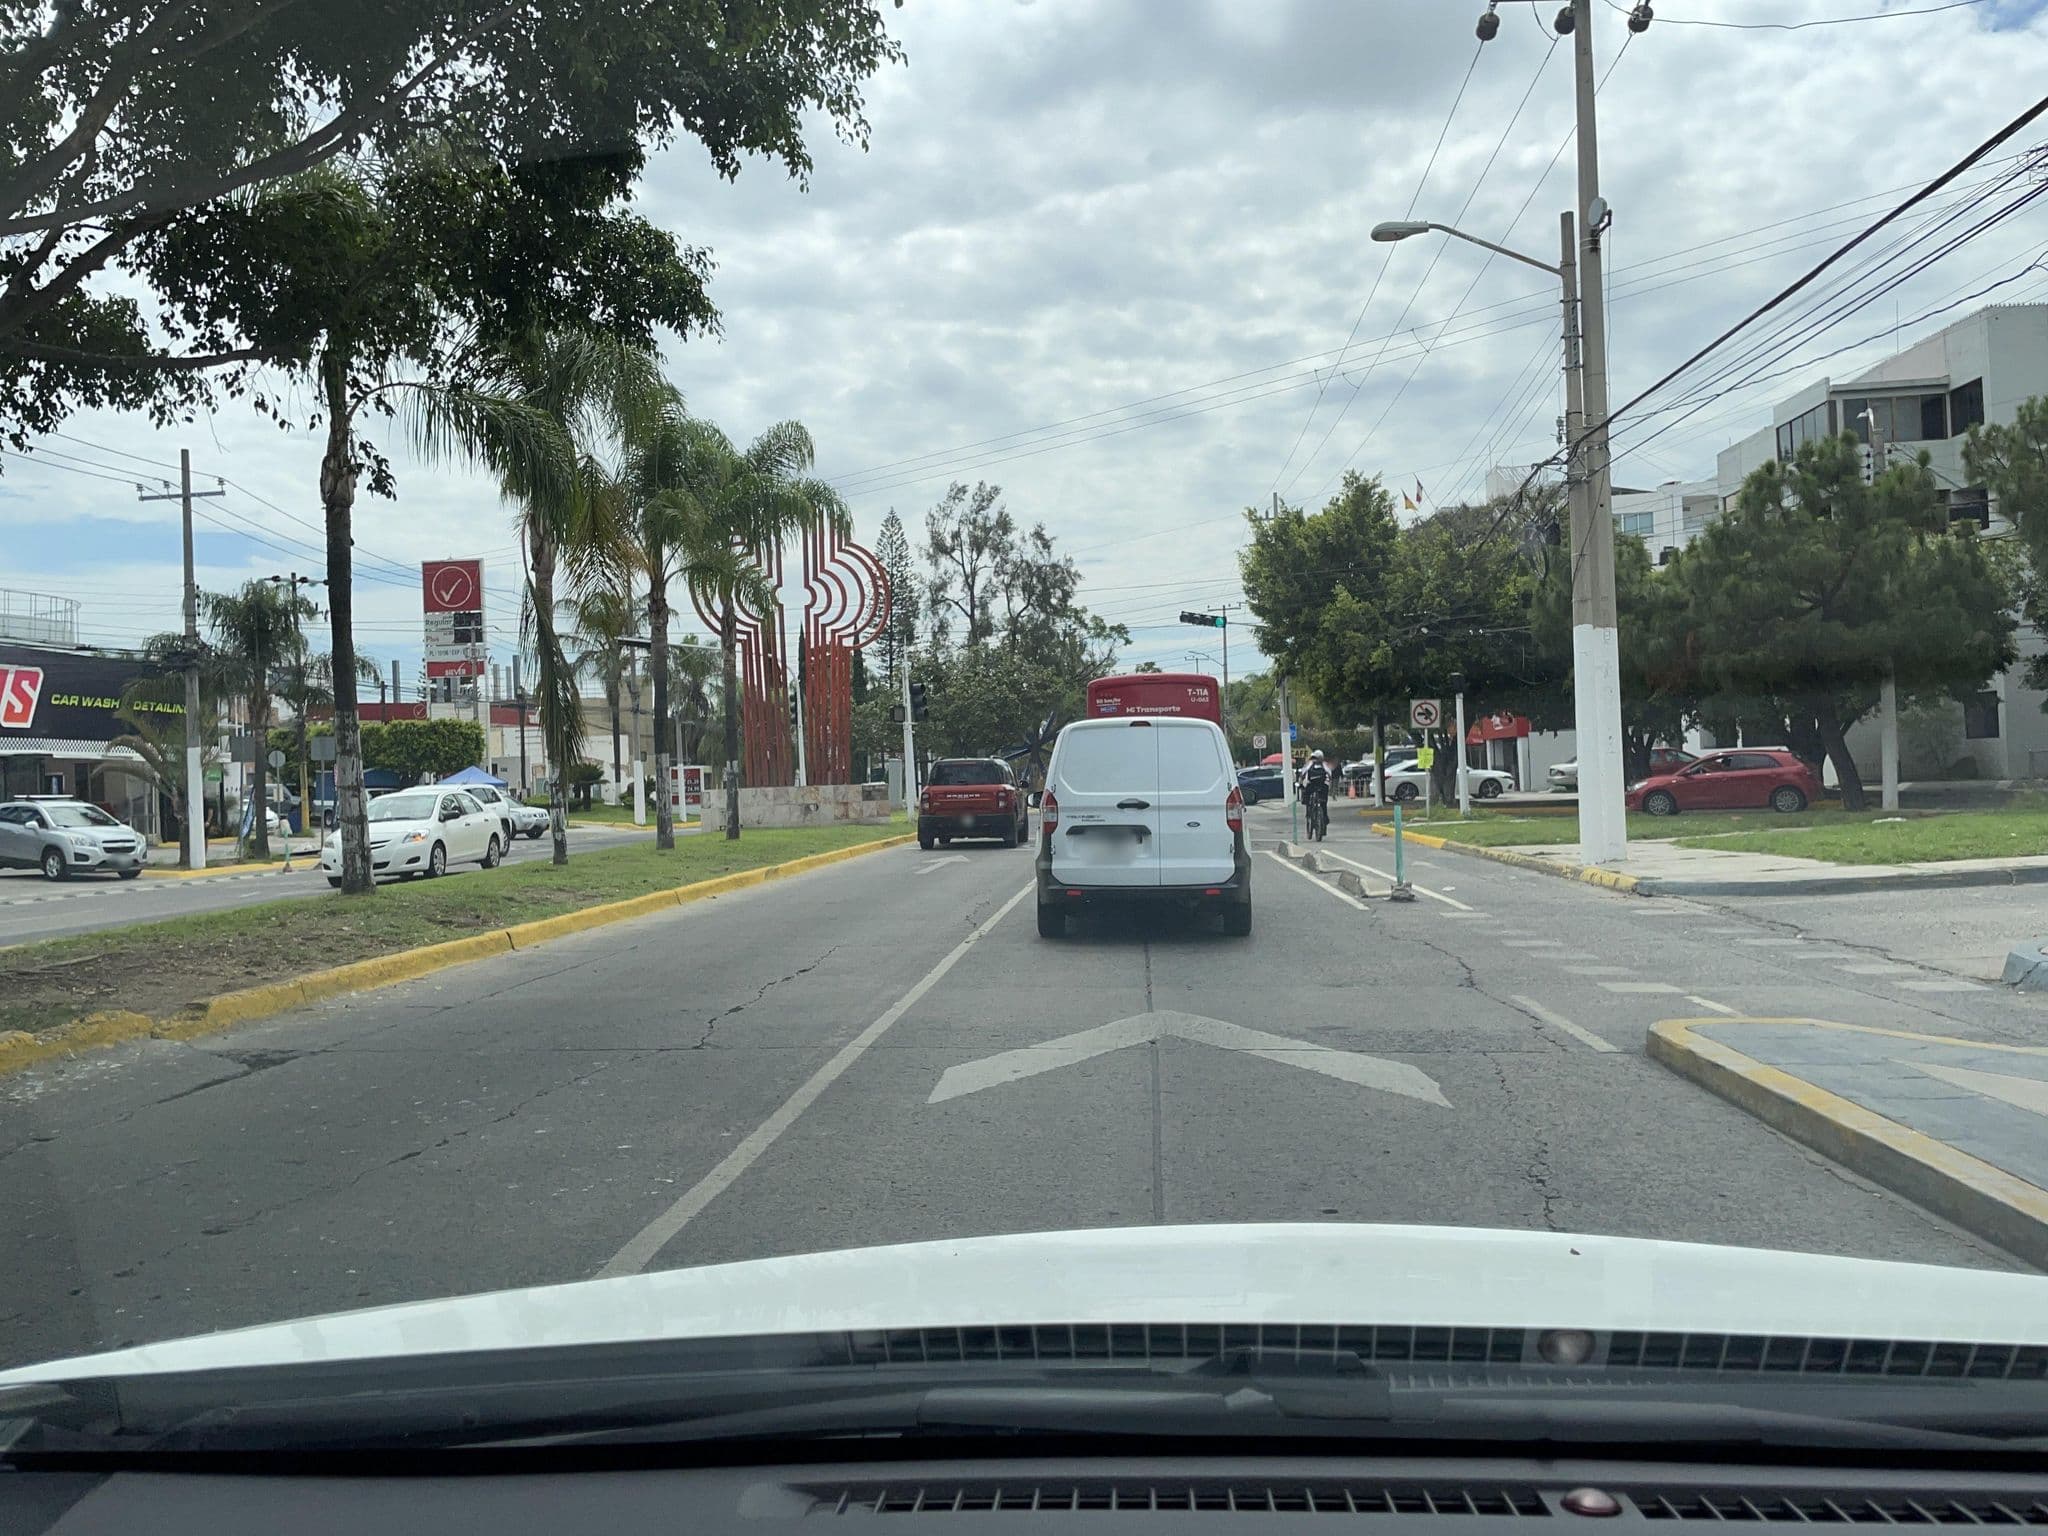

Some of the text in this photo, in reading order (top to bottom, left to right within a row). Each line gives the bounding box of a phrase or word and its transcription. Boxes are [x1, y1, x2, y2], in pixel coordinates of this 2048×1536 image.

[425, 619, 453, 627] Regular
[51, 694, 79, 707] CAR
[81, 696, 120, 709] WASH
[1136, 705, 1181, 714] Transporte
